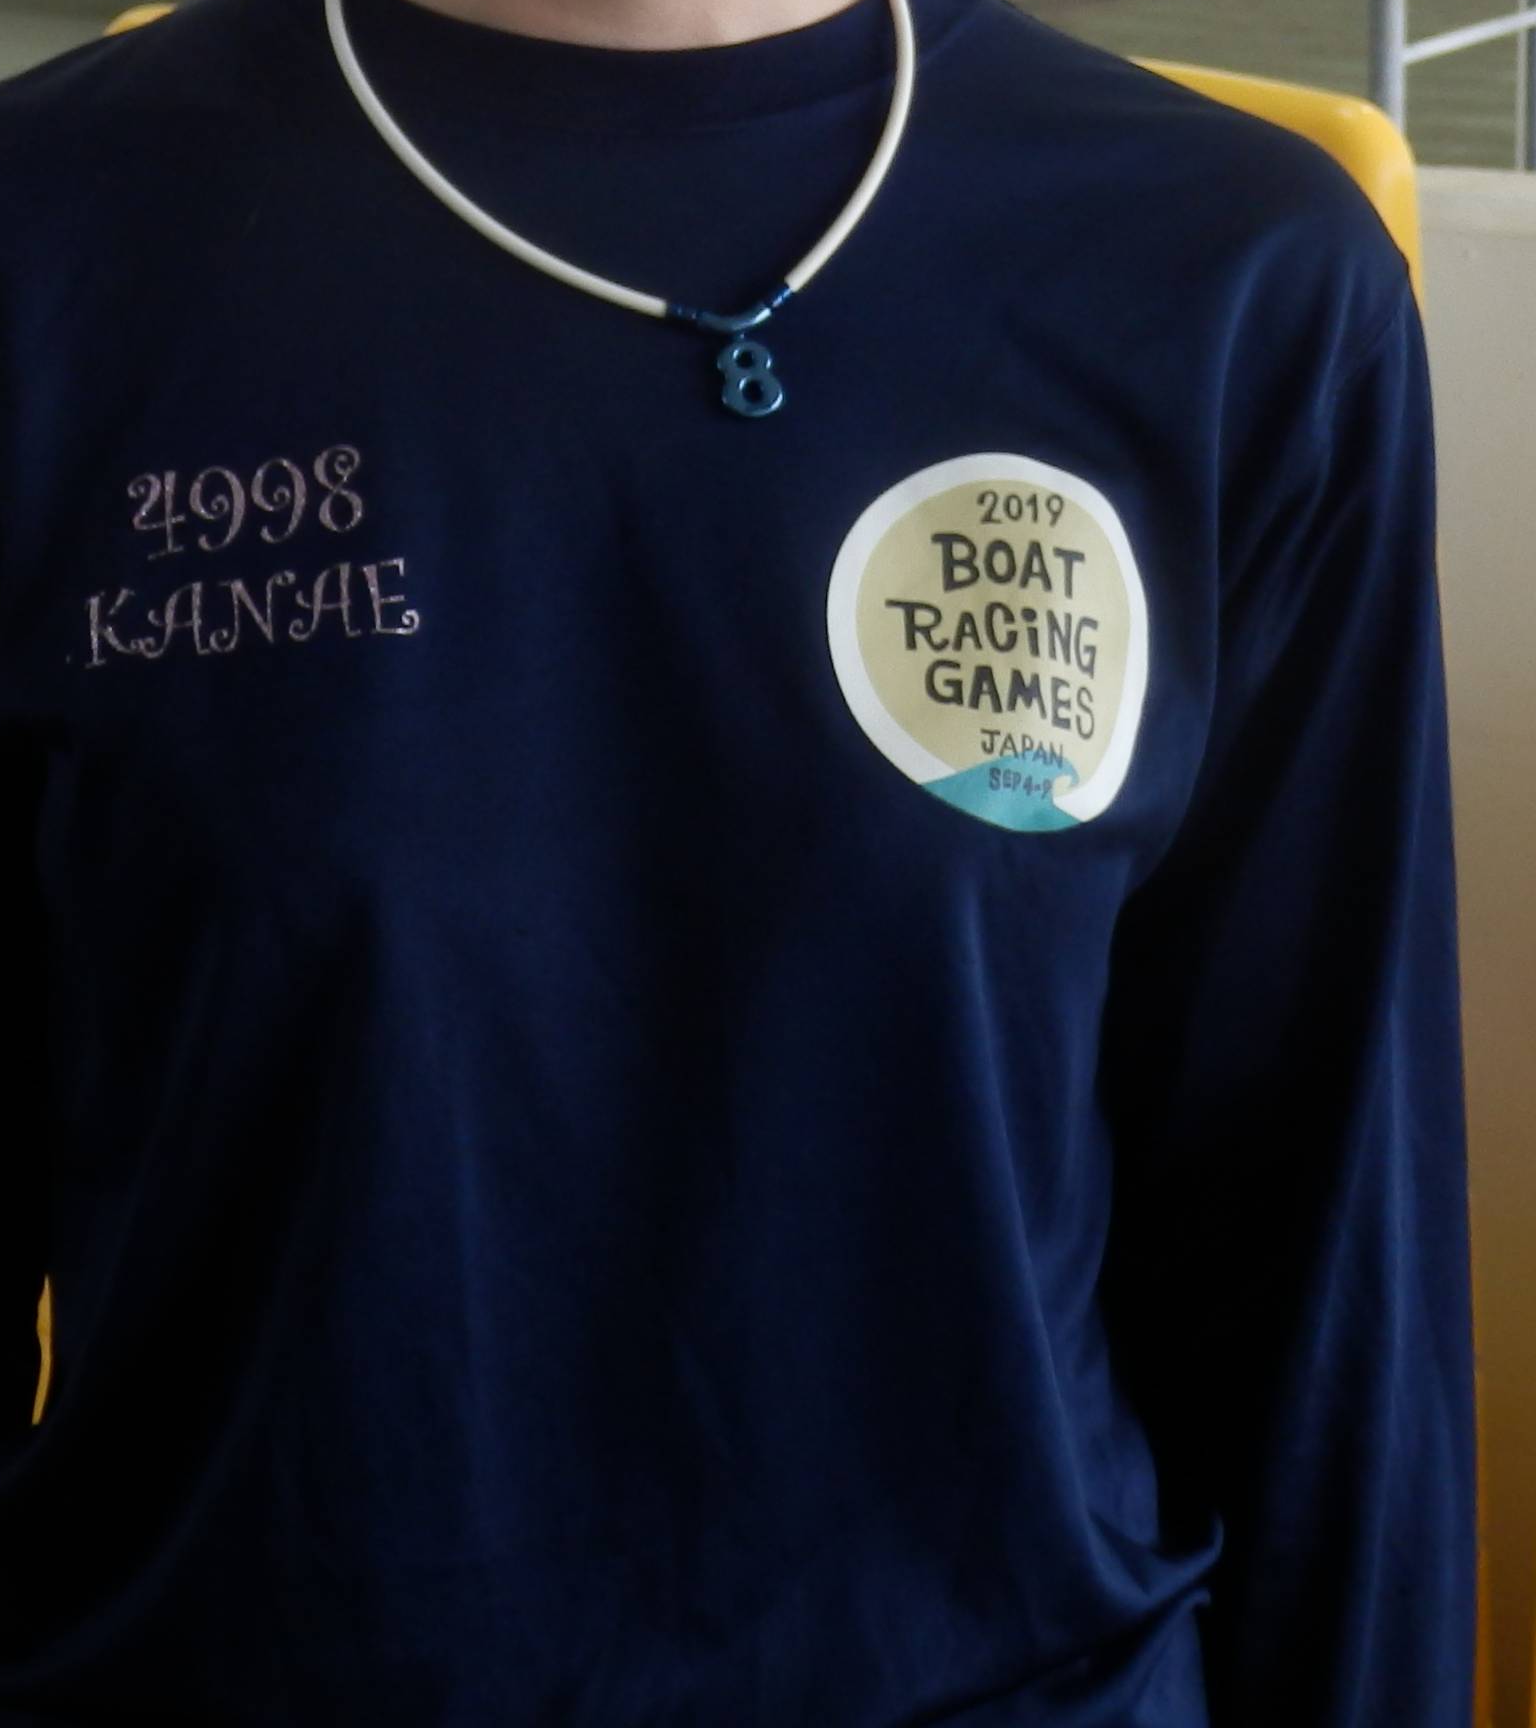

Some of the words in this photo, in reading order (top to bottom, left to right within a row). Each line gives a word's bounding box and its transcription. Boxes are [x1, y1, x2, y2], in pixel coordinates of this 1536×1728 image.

[126, 444, 364, 560] 4998
[977, 490, 1065, 526] 2019
[932, 532, 1085, 598] BOAT
[85, 557, 420, 668] KANAE
[925, 659, 1095, 740] GAMES
[980, 728, 1064, 770] JAPAN
